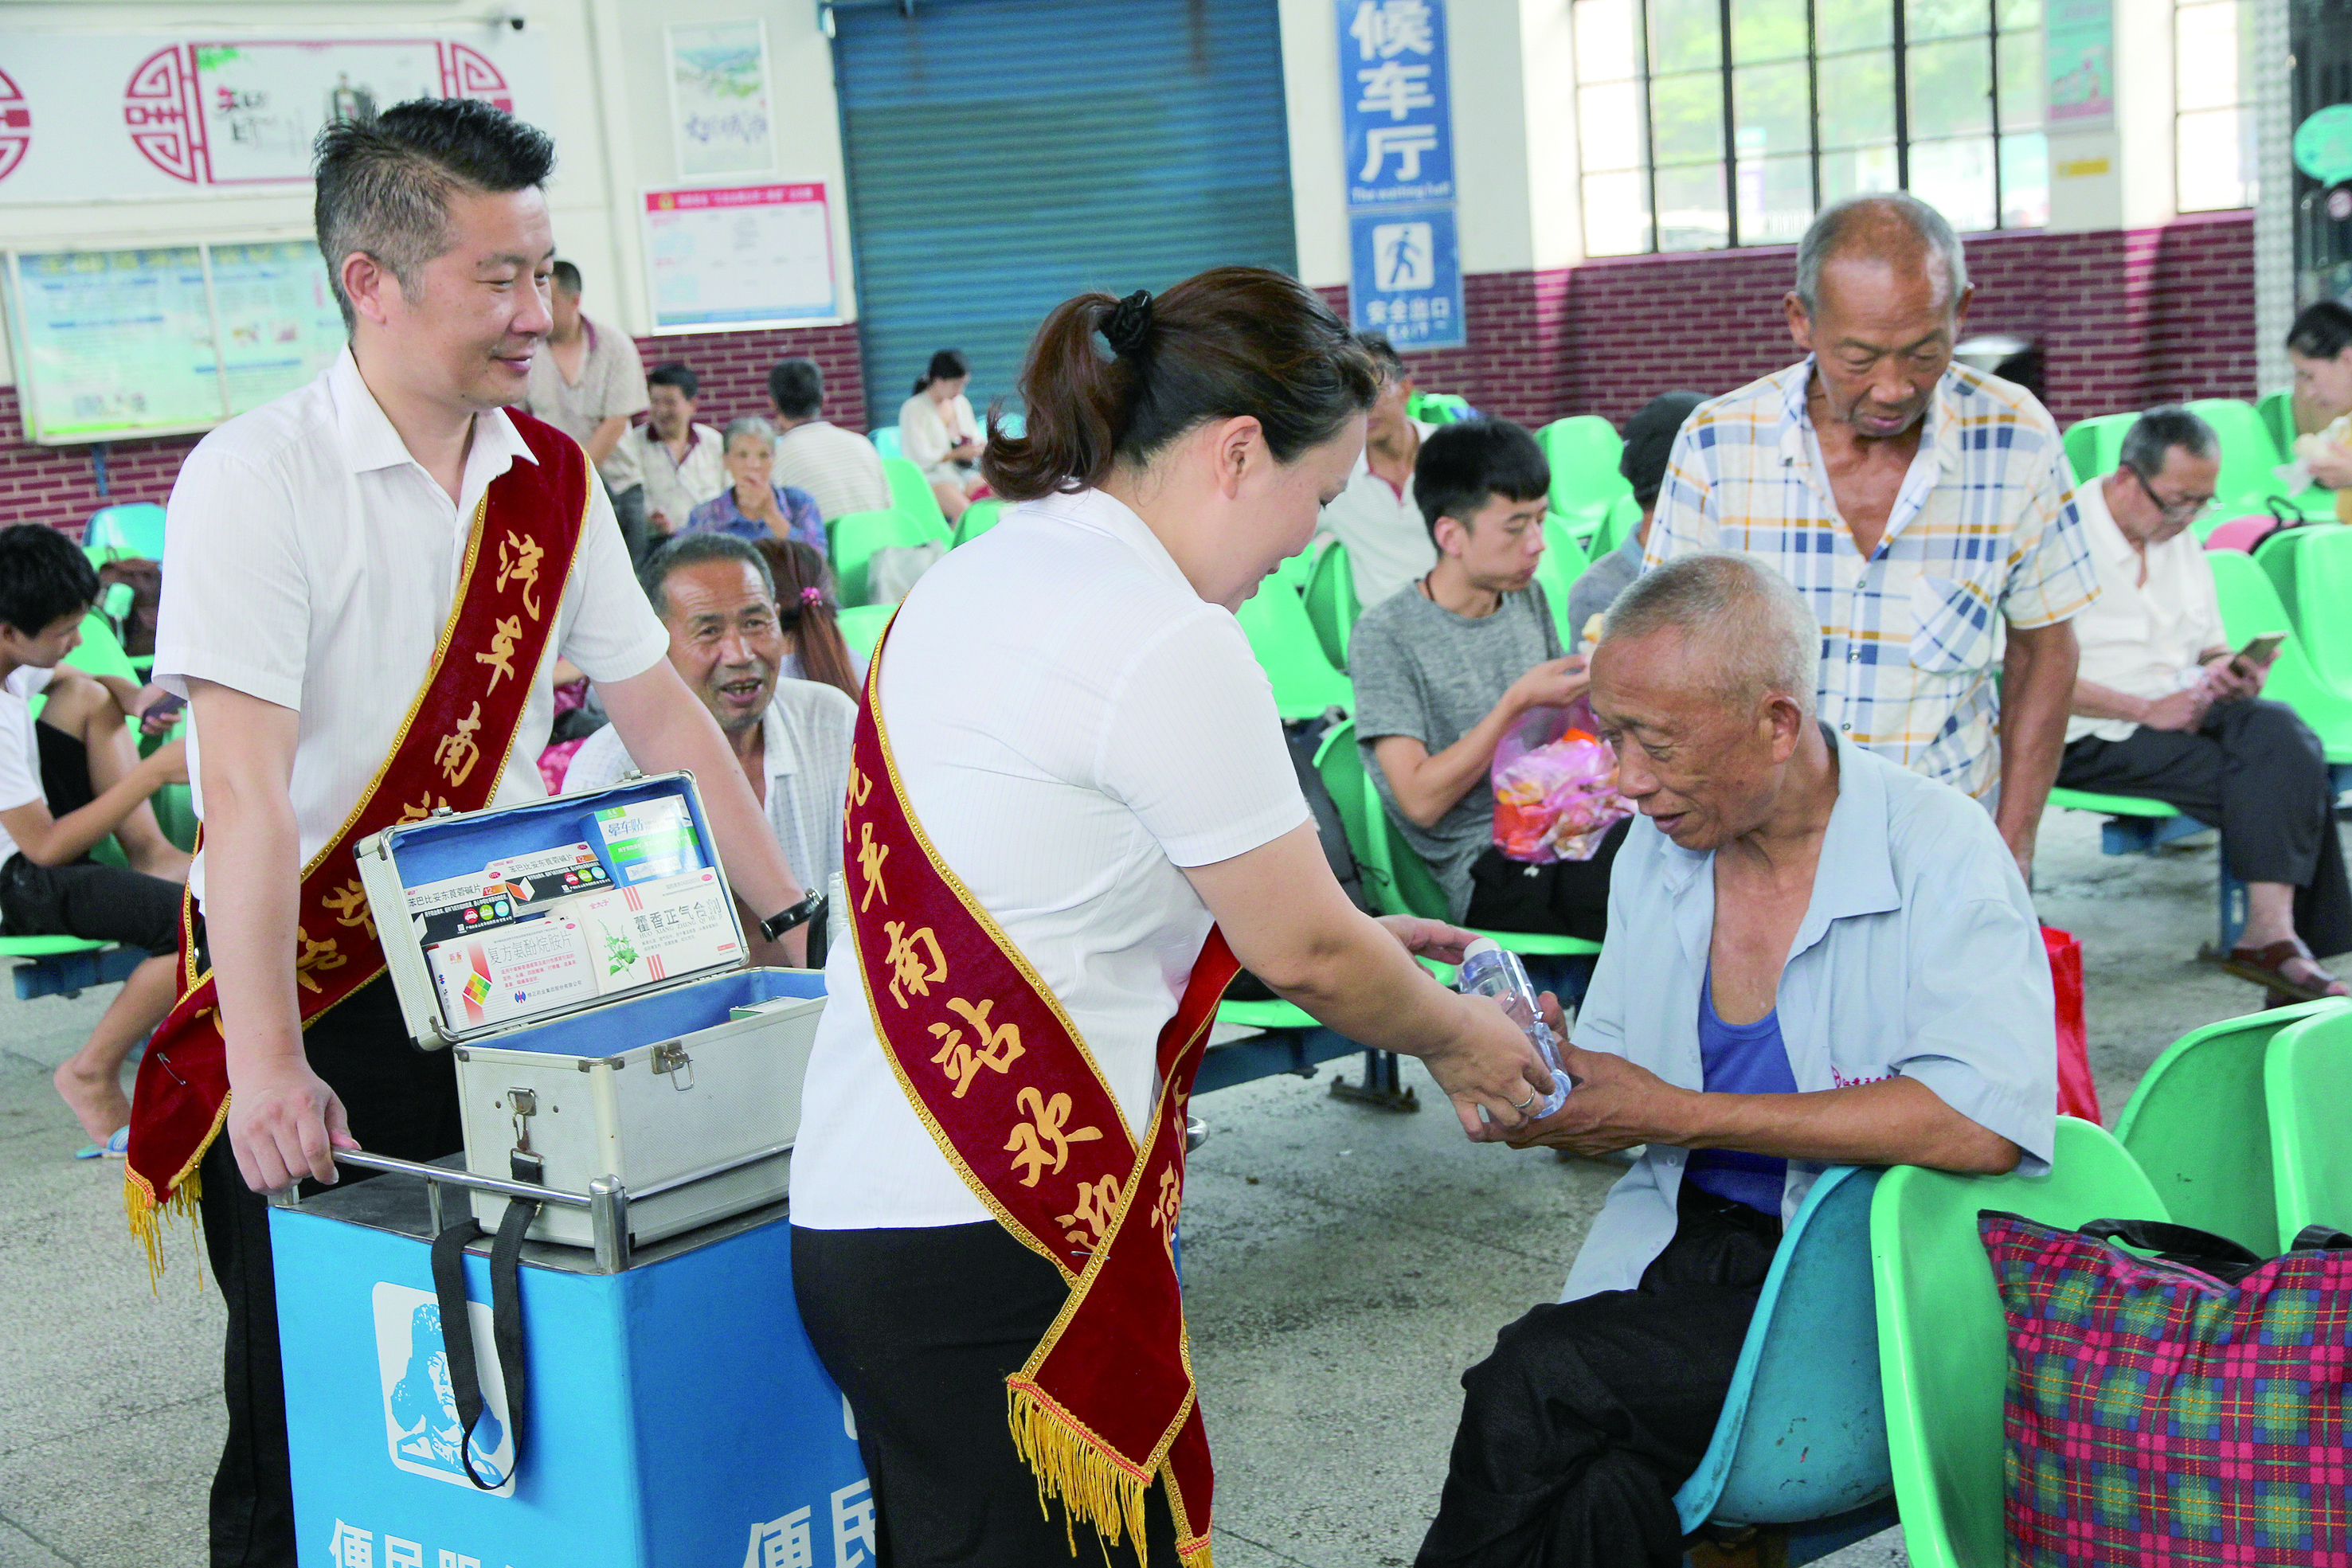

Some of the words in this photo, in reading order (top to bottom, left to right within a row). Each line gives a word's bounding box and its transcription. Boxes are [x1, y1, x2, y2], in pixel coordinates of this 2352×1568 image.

[1349, 0, 1438, 182] 候车厅
[1367, 296, 1450, 325] 安全出口
[634, 897, 722, 933] 藿香正气合剂
[656, 925, 674, 936] XIANG
[677, 920, 697, 929] ZHENG
[487, 931, 572, 965] 复方氨酚烷胺片
